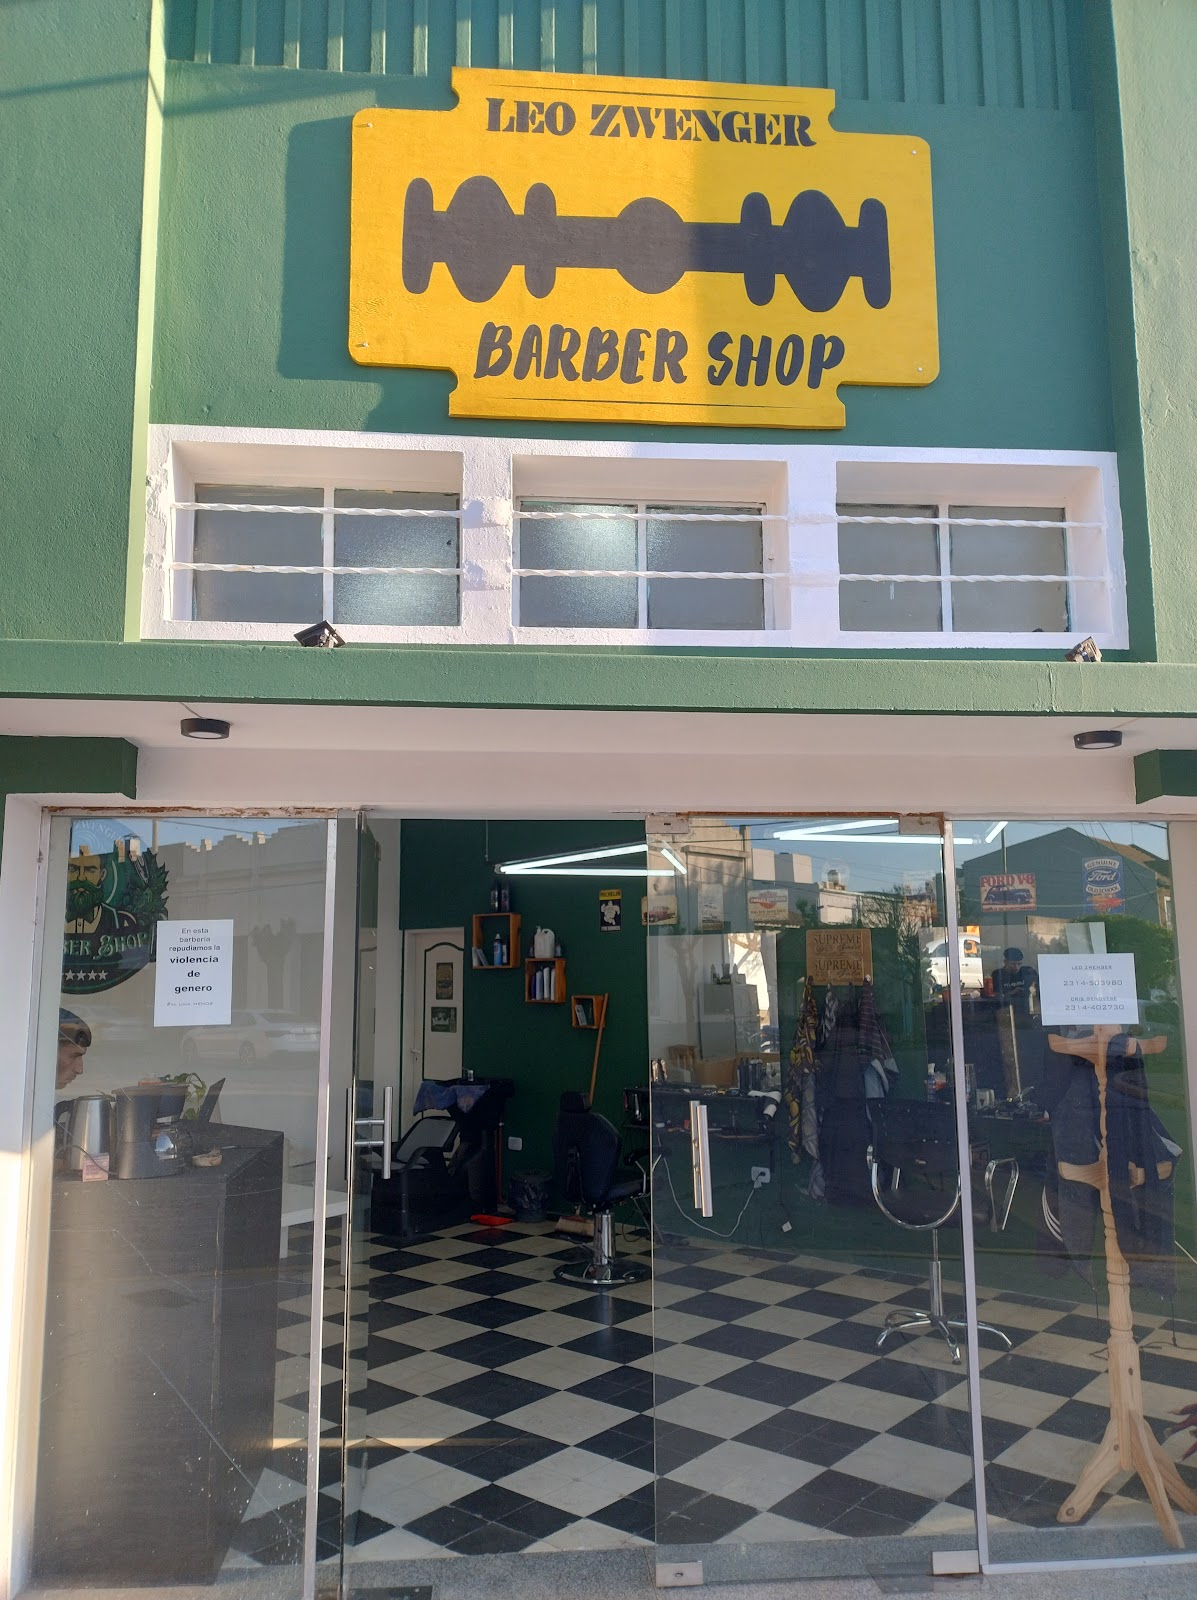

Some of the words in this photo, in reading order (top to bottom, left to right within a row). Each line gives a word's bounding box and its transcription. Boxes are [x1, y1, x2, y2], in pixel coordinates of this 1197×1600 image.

[485, 97, 577, 137] LEO
[590, 104, 817, 148] ZWENGER
[474, 321, 689, 385] BARBER
[706, 331, 846, 389] SHOP
[1087, 859, 1118, 868] GENUINE
[981, 874, 1015, 887] FORD
[1087, 870, 1117, 881] Ford
[814, 933, 861, 945] SUPREME
[168, 945, 212, 953] repudiamos
[170, 955, 219, 964] violencia
[814, 959, 862, 971] SUPREME
[187, 970, 201, 978] de
[174, 985, 213, 994] genero
